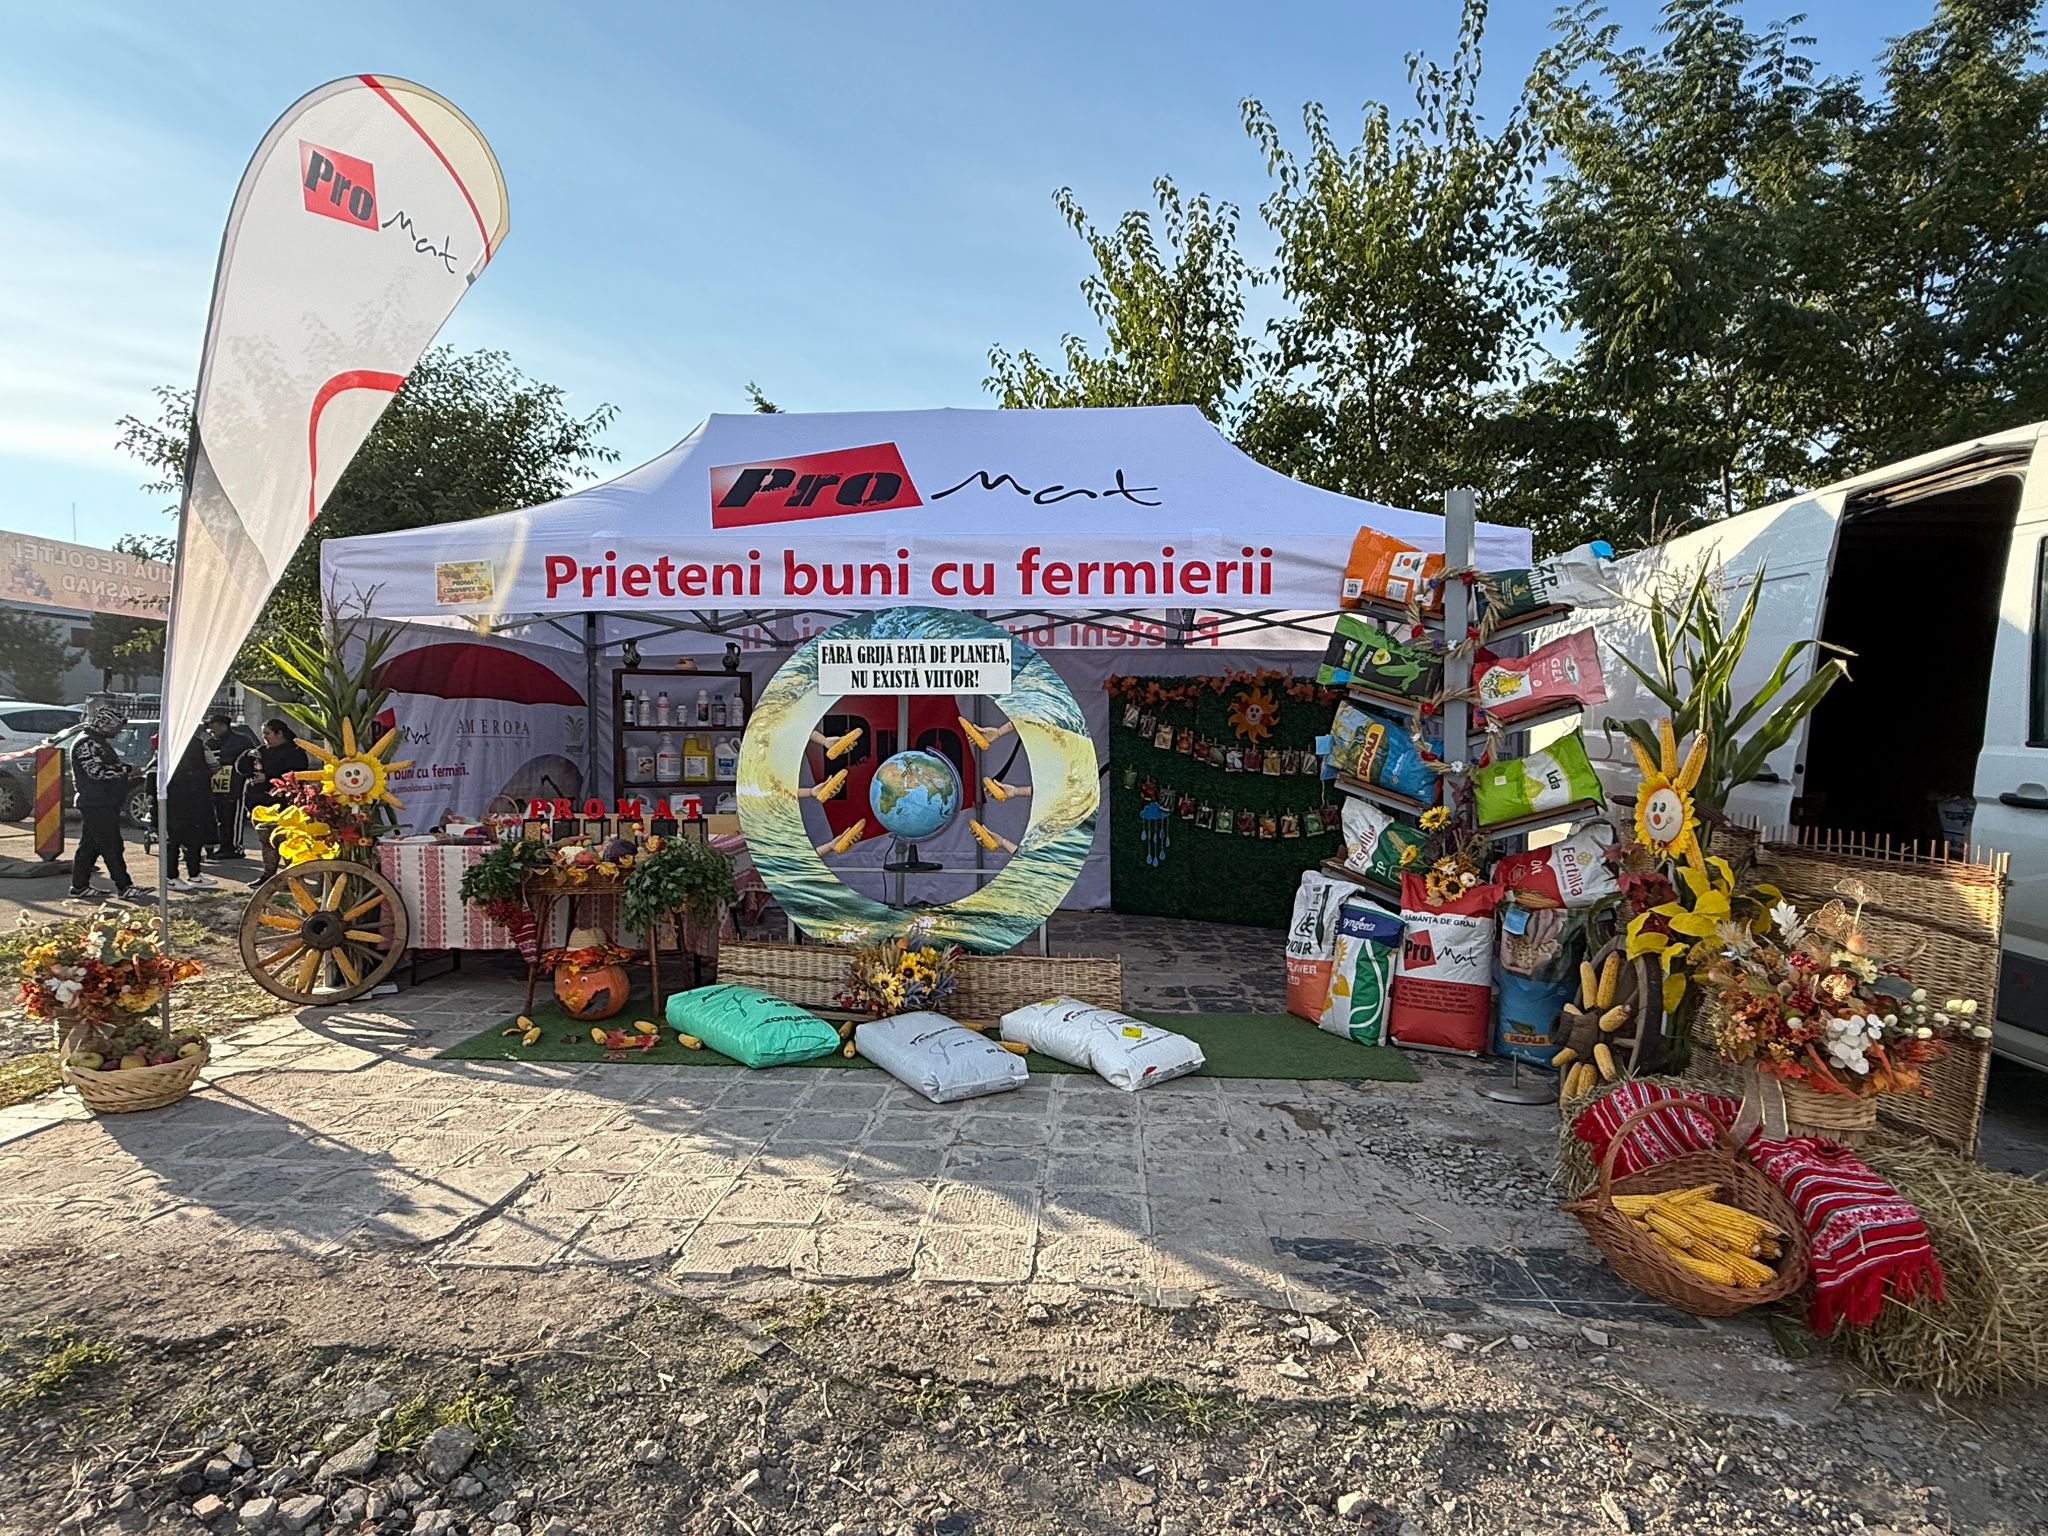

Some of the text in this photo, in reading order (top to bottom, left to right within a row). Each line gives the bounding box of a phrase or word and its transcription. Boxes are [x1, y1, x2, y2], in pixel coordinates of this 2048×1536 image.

[304, 150, 457, 275] Pro Mat
[717, 468, 1163, 507] Pro Mat
[544, 547, 1274, 599] Prieteni buni cu fermierii
[821, 642, 1010, 668] FĂRĂ GRIJĂ FAȚĂ DE PLANETĂ,
[850, 667, 980, 689] NU EXISTĂ VIITOR!
[1359, 731, 1380, 777] DEKALB
[529, 797, 704, 821] PROMAT
[1374, 861, 1388, 877] ZP
[1560, 847, 1583, 897] Fertillia
[1440, 917, 1452, 926] DE
[1404, 940, 1477, 967] Pro Mat
